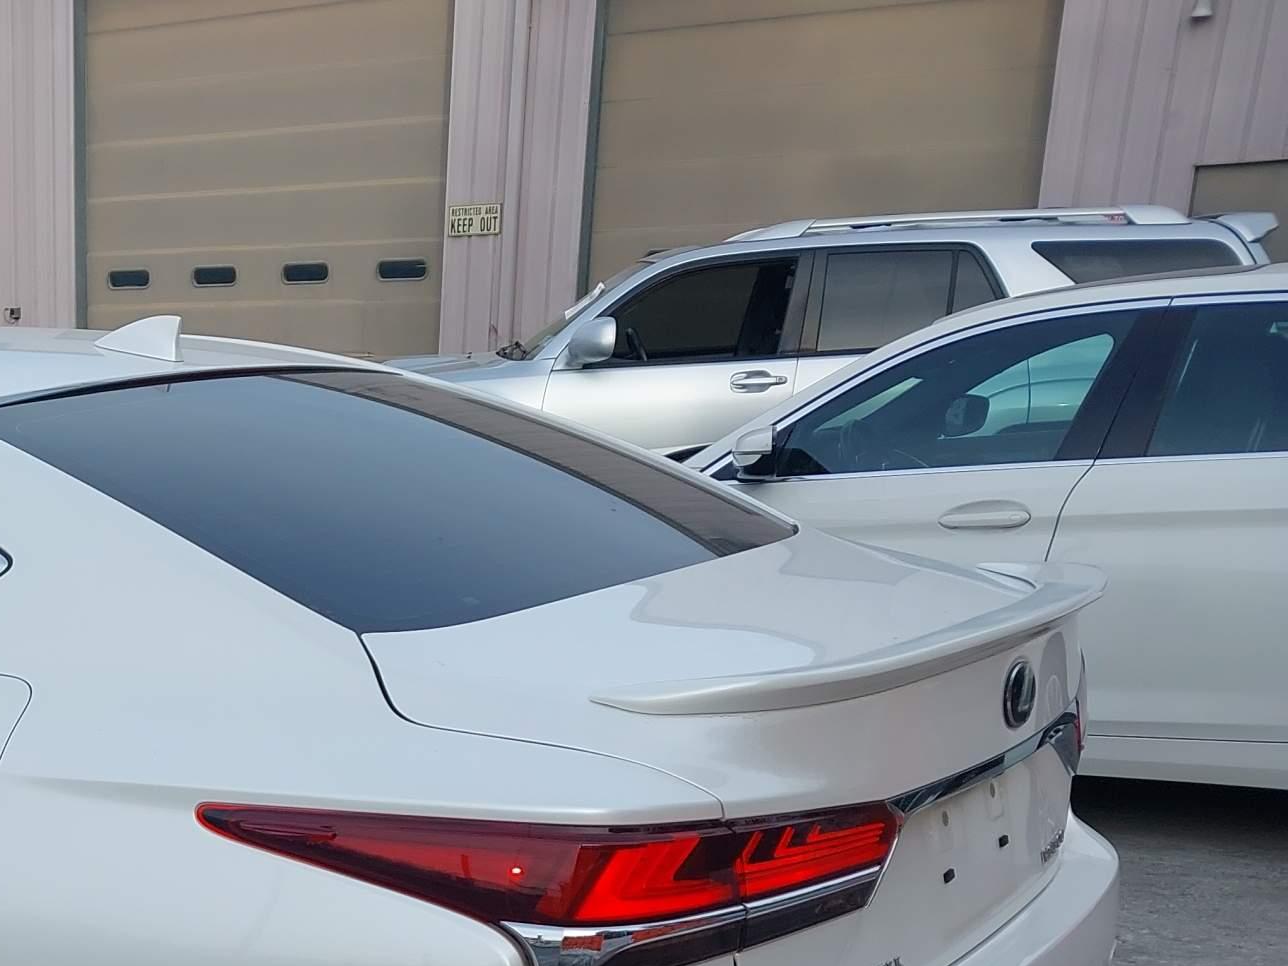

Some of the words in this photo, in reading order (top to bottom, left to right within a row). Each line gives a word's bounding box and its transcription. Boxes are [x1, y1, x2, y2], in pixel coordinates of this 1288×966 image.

[451, 207, 481, 216] RESTRICTED
[485, 205, 498, 214] AREA
[450, 217, 474, 233] KEEP
[480, 216, 498, 232] OUT
